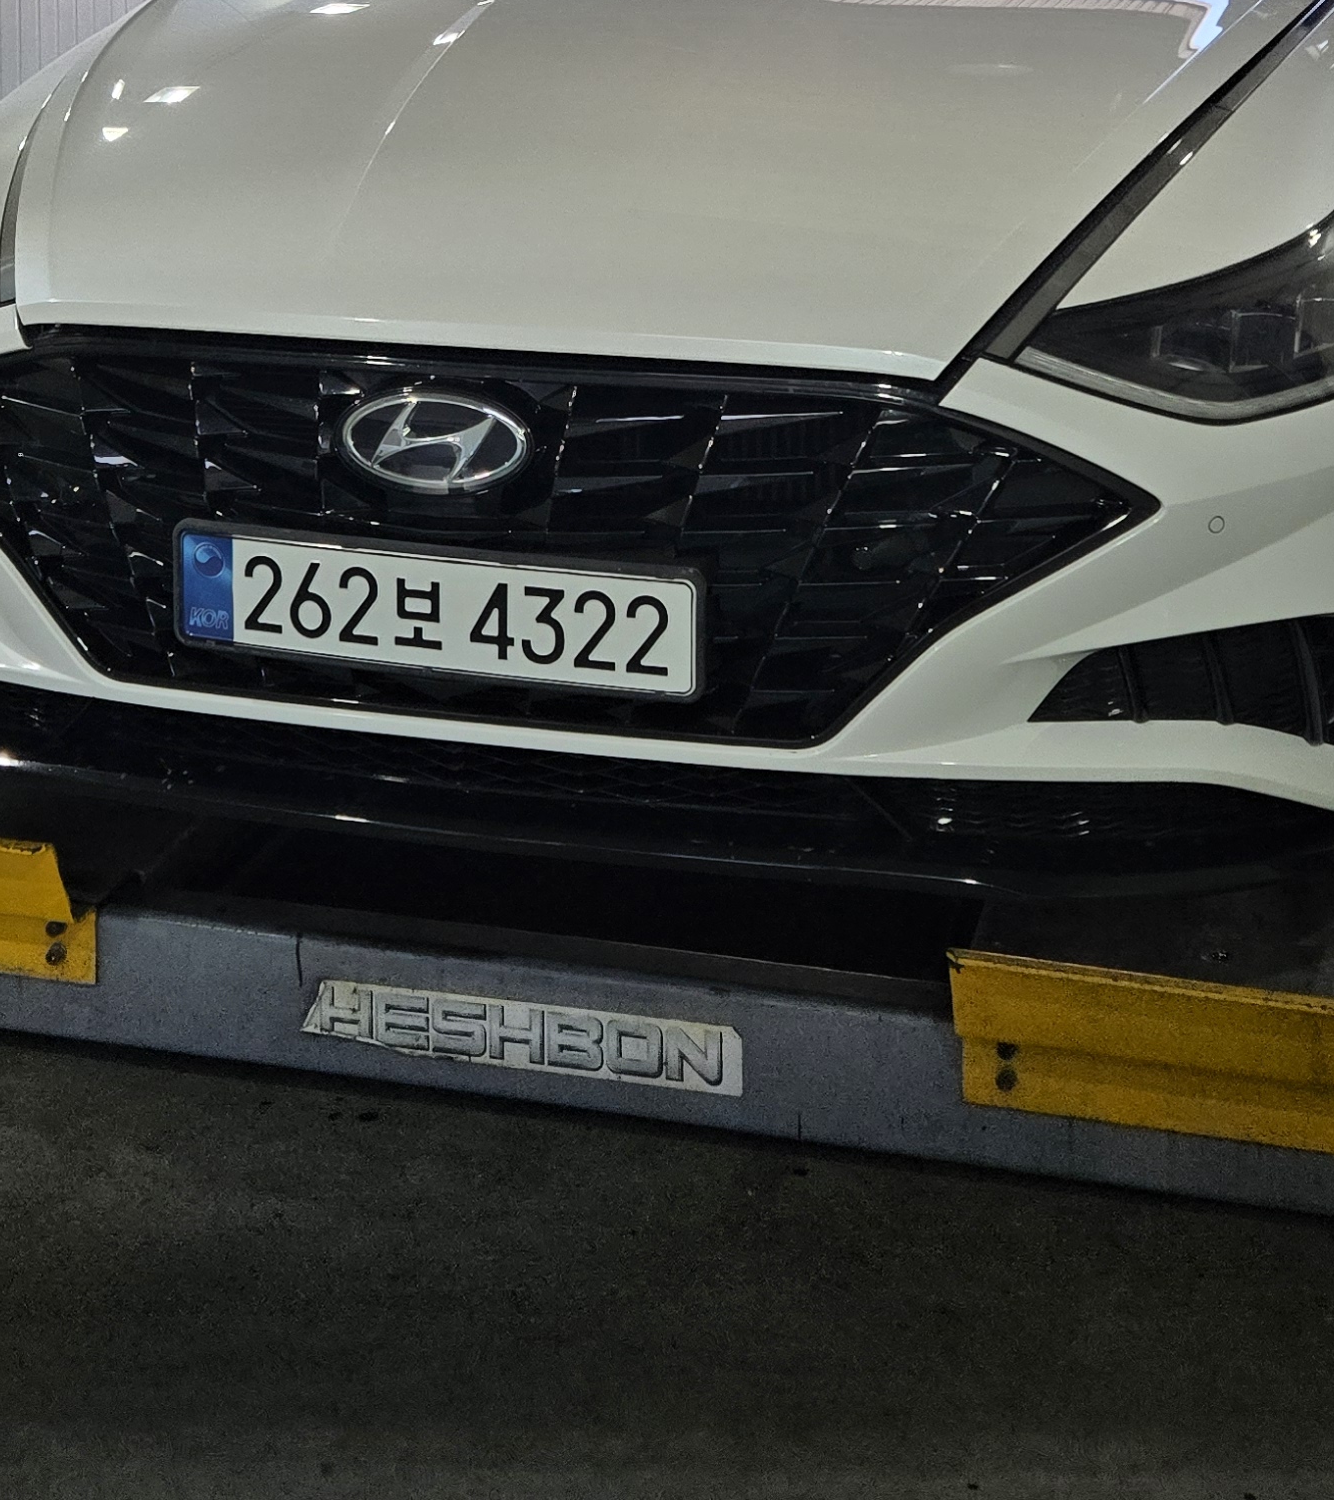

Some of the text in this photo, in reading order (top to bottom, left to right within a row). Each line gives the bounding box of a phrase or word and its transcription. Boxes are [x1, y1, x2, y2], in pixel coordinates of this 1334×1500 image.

[189, 606, 229, 631] KOR
[244, 555, 670, 677] 262보 4322
[320, 985, 724, 1087] HESHBON
